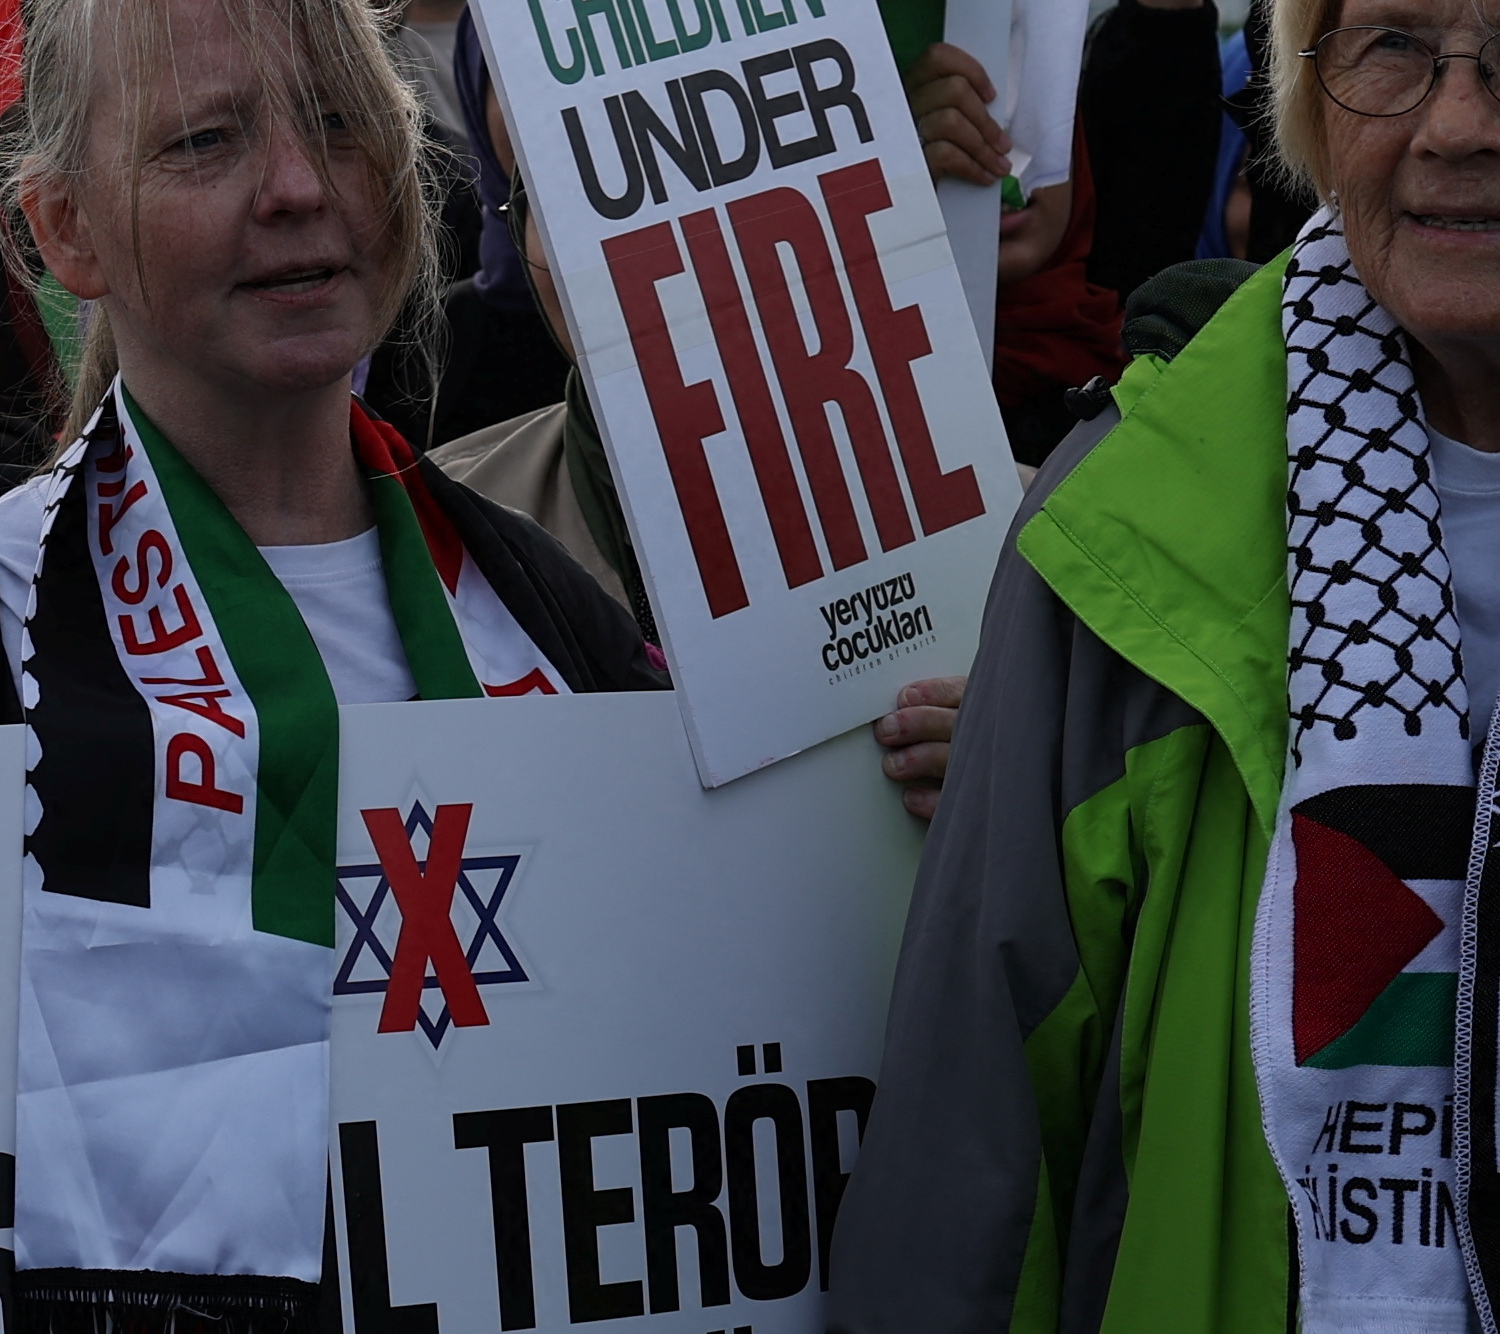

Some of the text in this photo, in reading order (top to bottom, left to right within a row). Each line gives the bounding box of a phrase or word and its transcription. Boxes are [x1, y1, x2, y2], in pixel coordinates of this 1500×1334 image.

[561, 37, 875, 220] UNDER
[601, 157, 986, 620] FIRE
[819, 572, 916, 641] yeryüzü
[828, 658, 882, 686] children
[905, 634, 938, 654] earth
